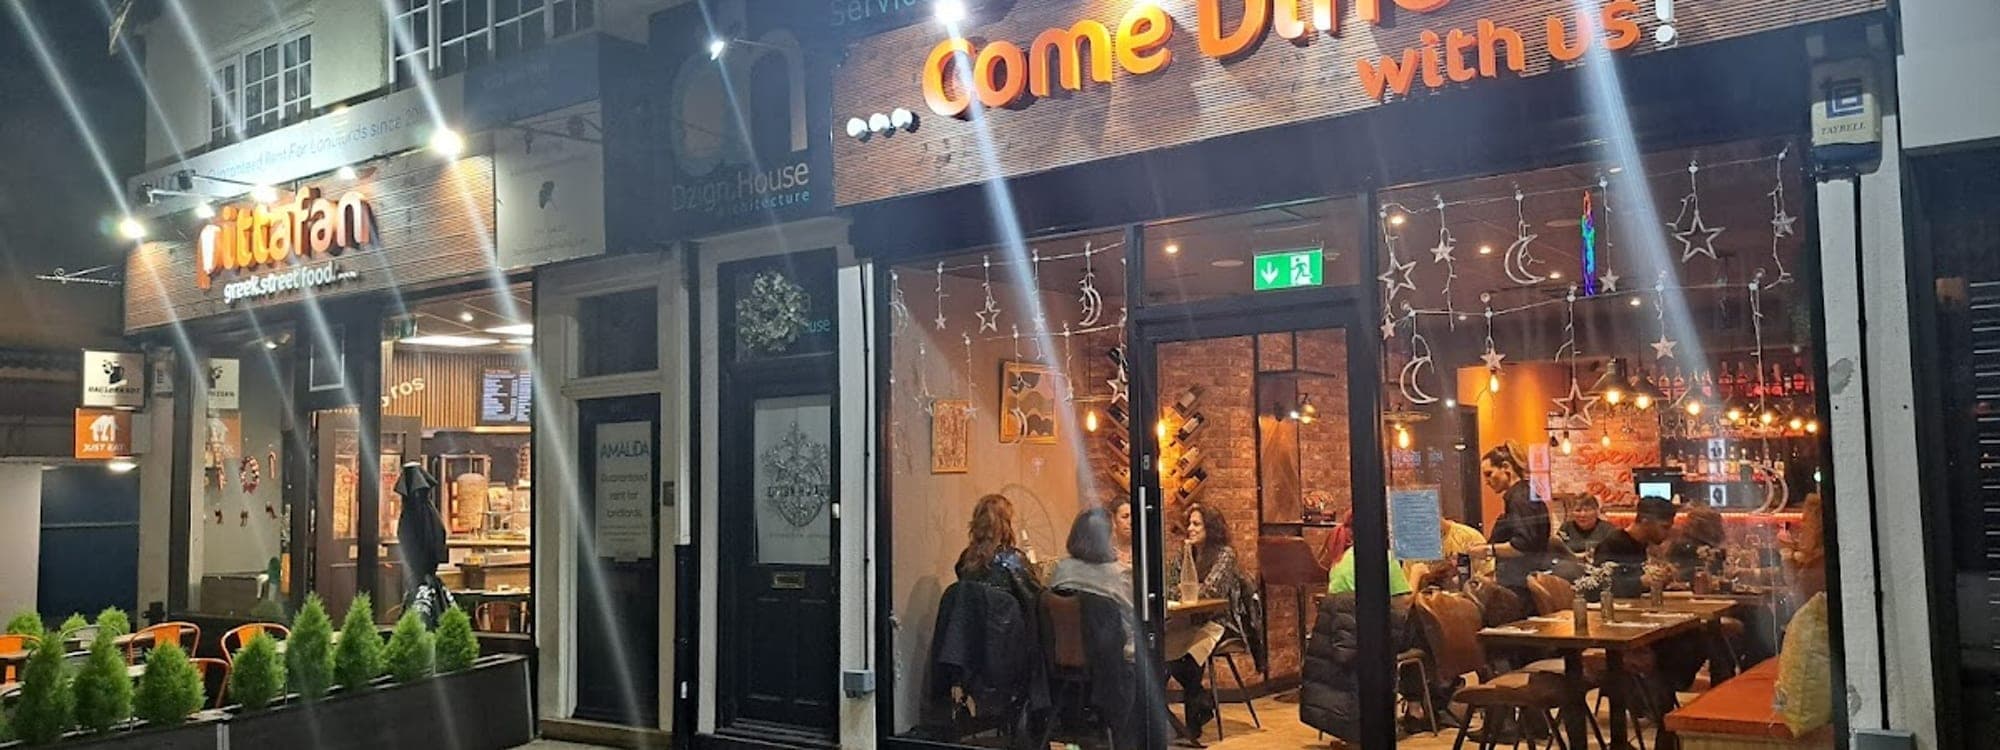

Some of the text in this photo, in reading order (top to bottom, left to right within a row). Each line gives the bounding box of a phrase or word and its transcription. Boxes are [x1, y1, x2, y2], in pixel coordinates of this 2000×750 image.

[922, 4, 1174, 117] Come
[1197, 0, 1453, 59] Di
[1356, 18, 1525, 100] with
[369, 118, 401, 138] since
[737, 163, 809, 198] House
[197, 185, 370, 290] pittafan
